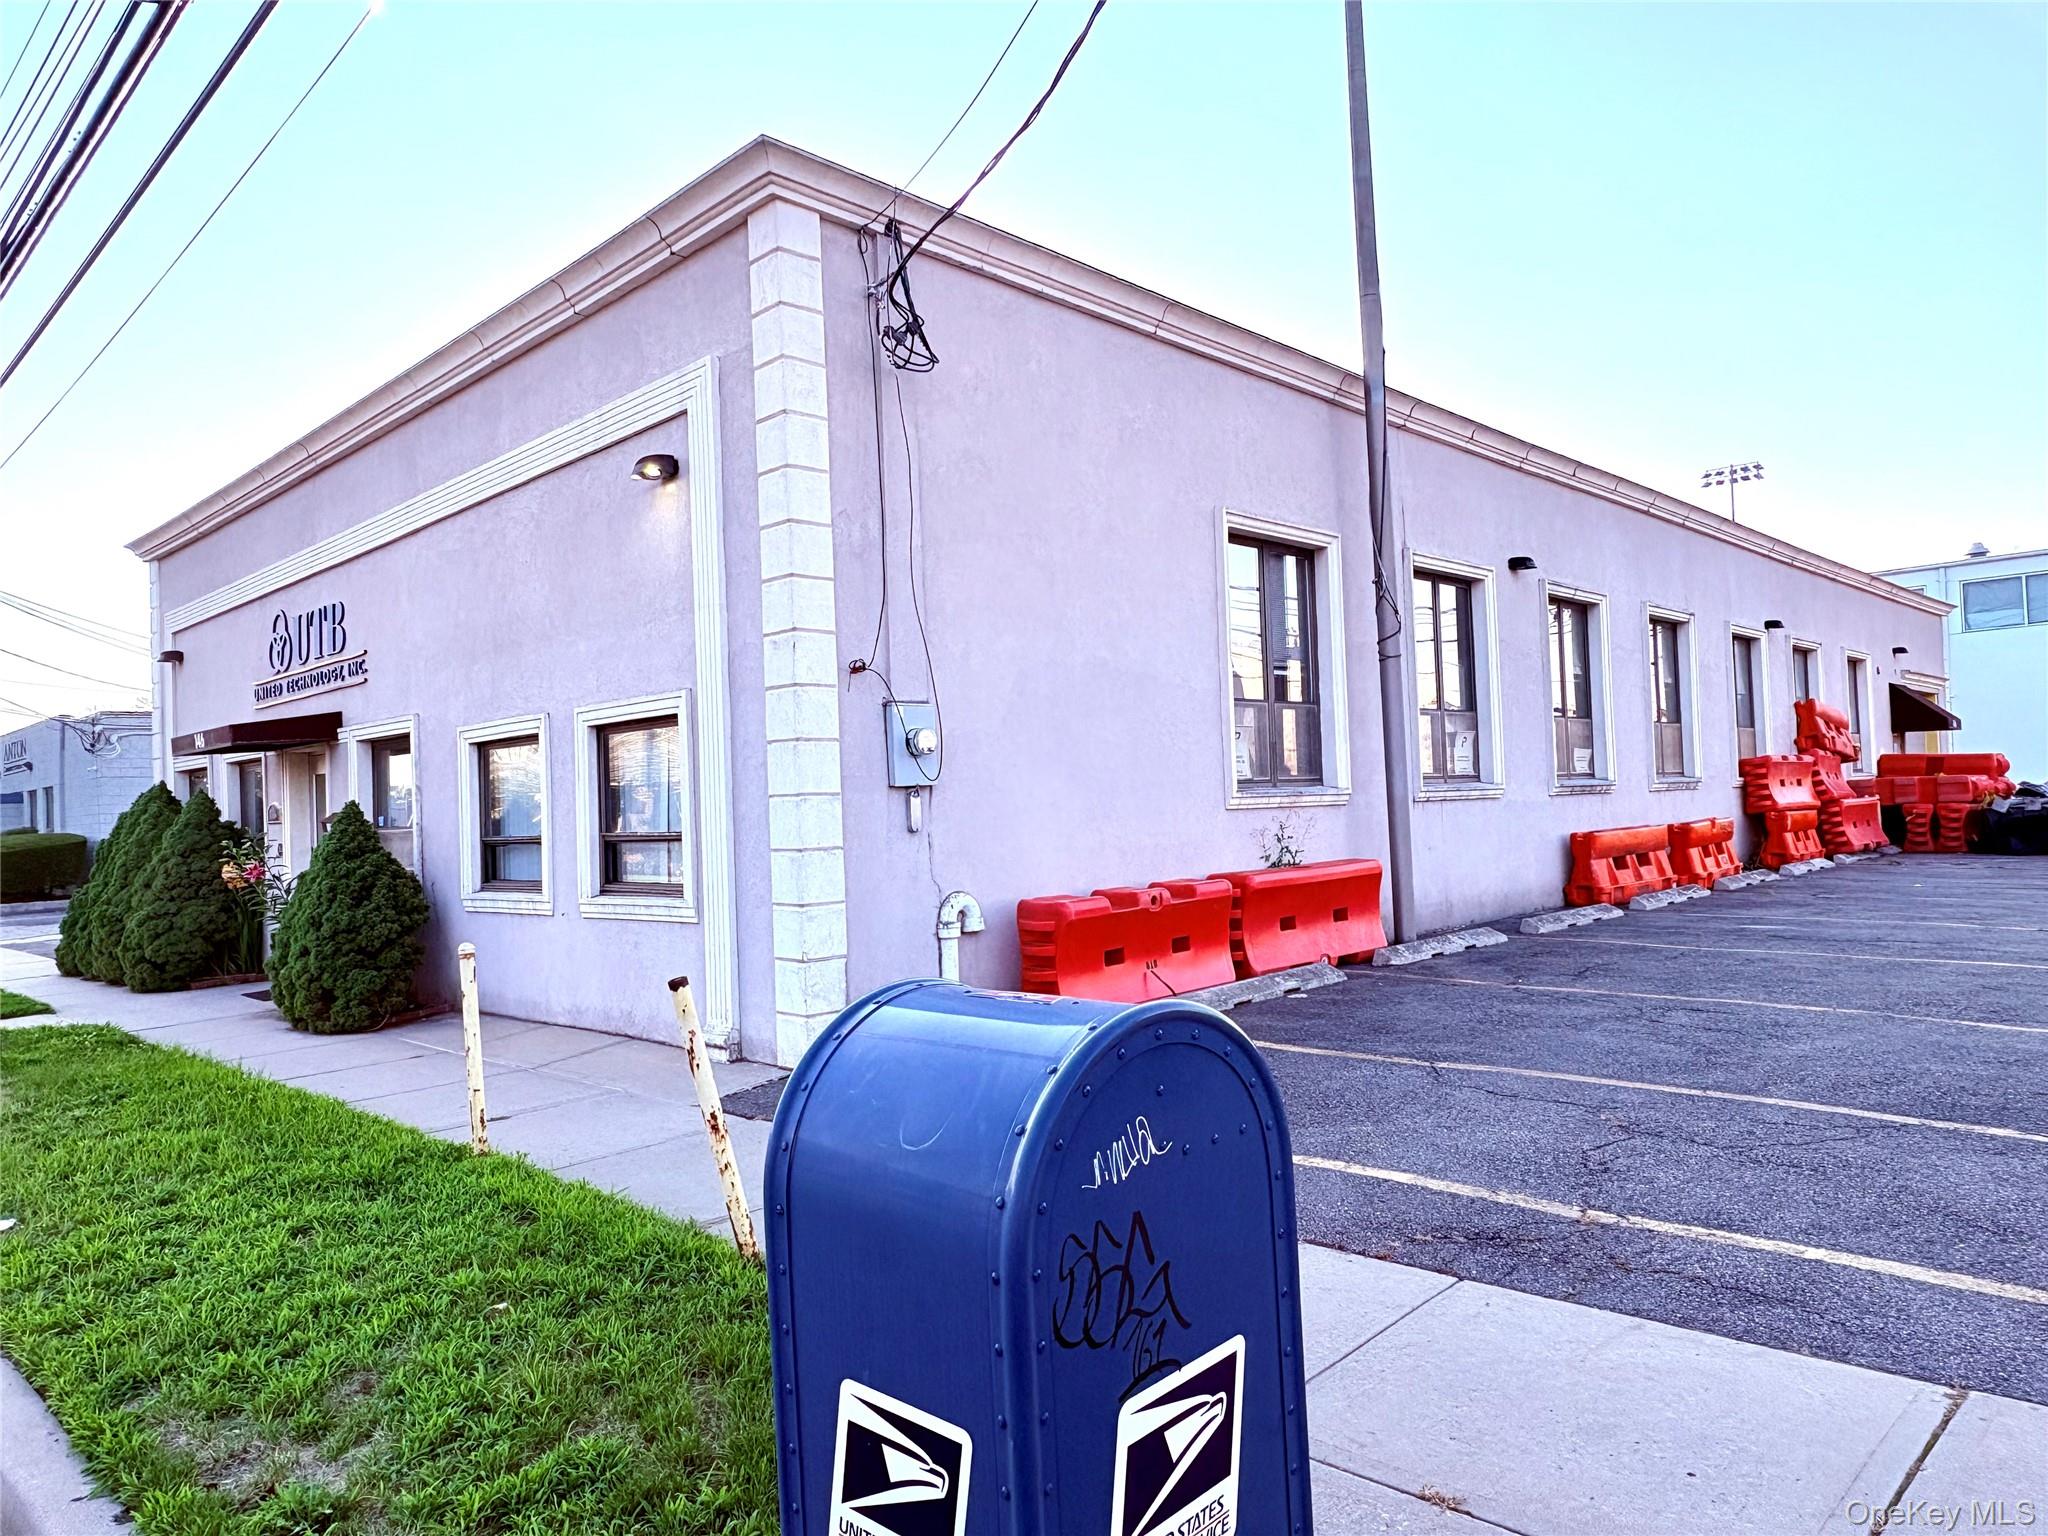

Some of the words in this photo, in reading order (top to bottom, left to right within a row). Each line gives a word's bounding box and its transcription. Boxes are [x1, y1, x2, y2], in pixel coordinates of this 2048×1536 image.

[292, 601, 347, 666] UTB
[254, 683, 283, 702] UNITED
[1177, 1494, 1225, 1536] STATES
